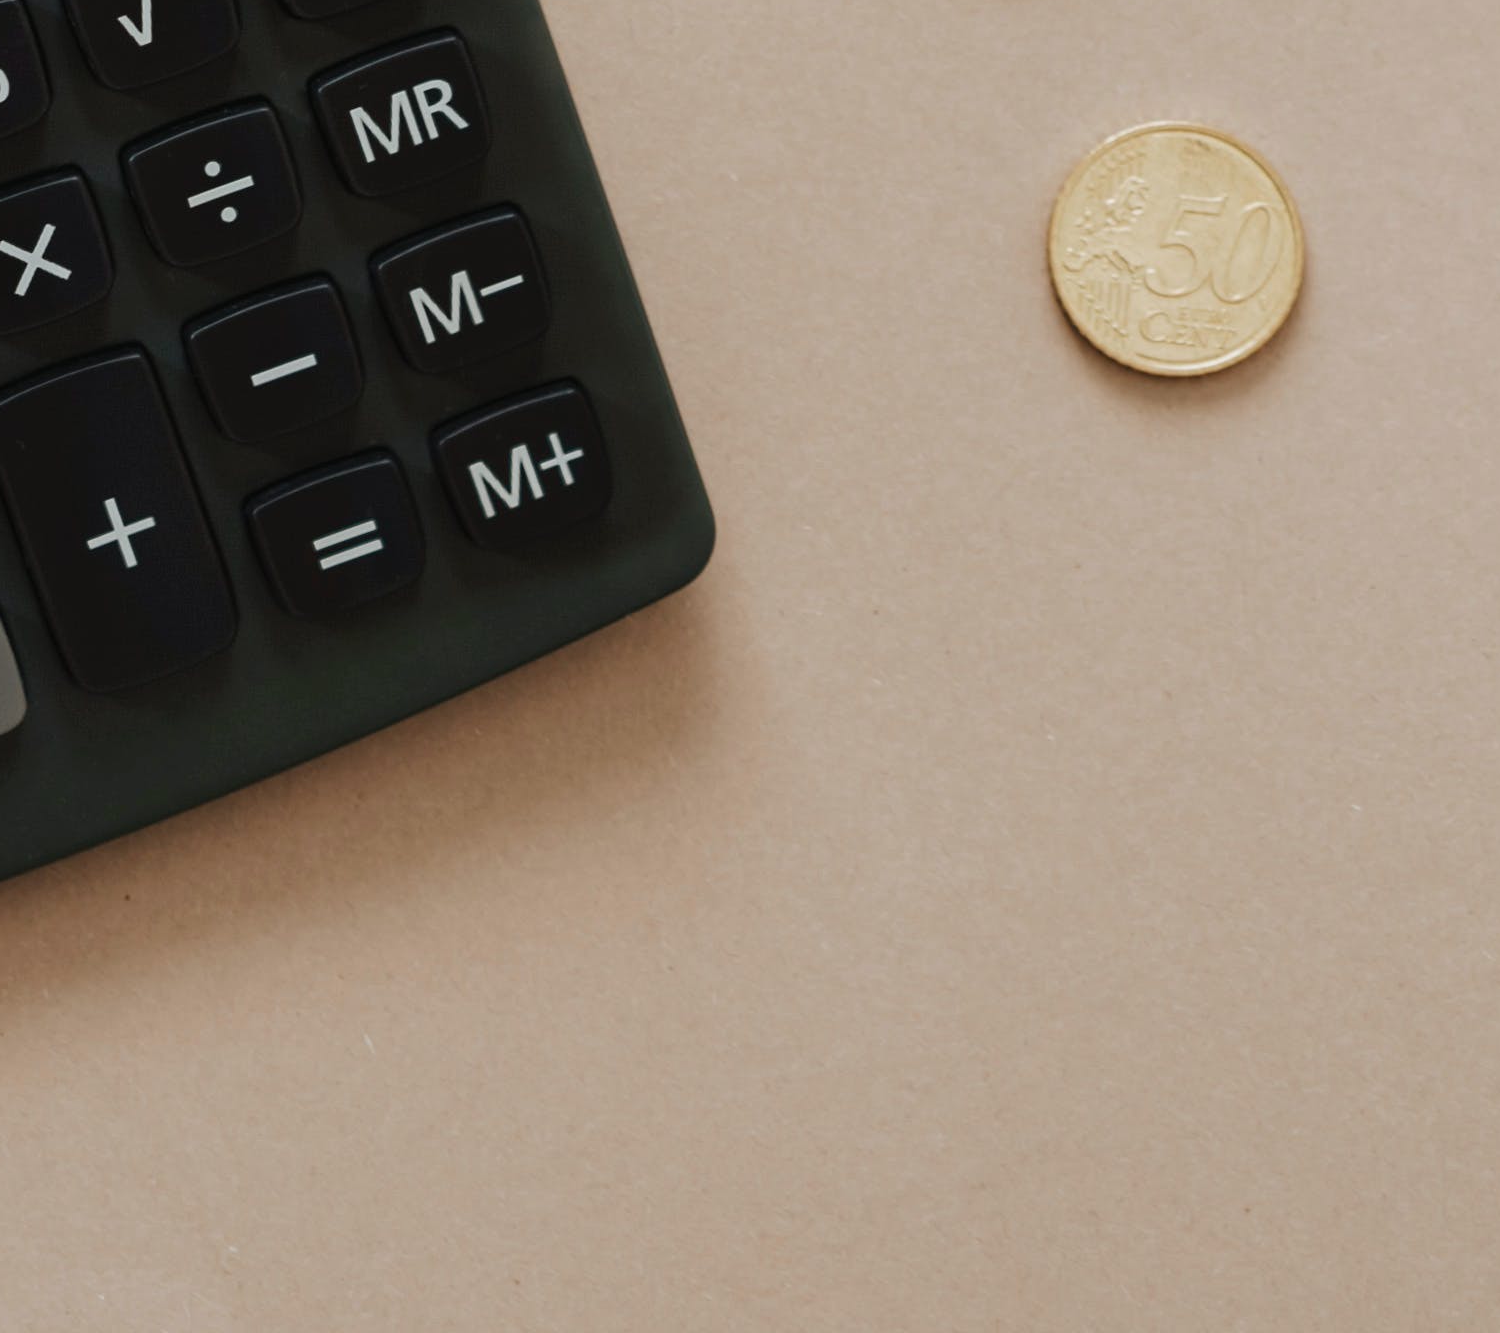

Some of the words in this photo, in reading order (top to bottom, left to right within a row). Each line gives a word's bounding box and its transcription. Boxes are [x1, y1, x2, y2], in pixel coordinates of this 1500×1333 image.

[349, 79, 469, 163] MR
[1144, 194, 1284, 305] 50
[1139, 310, 1239, 351] CENT
[468, 432, 584, 518] M+
